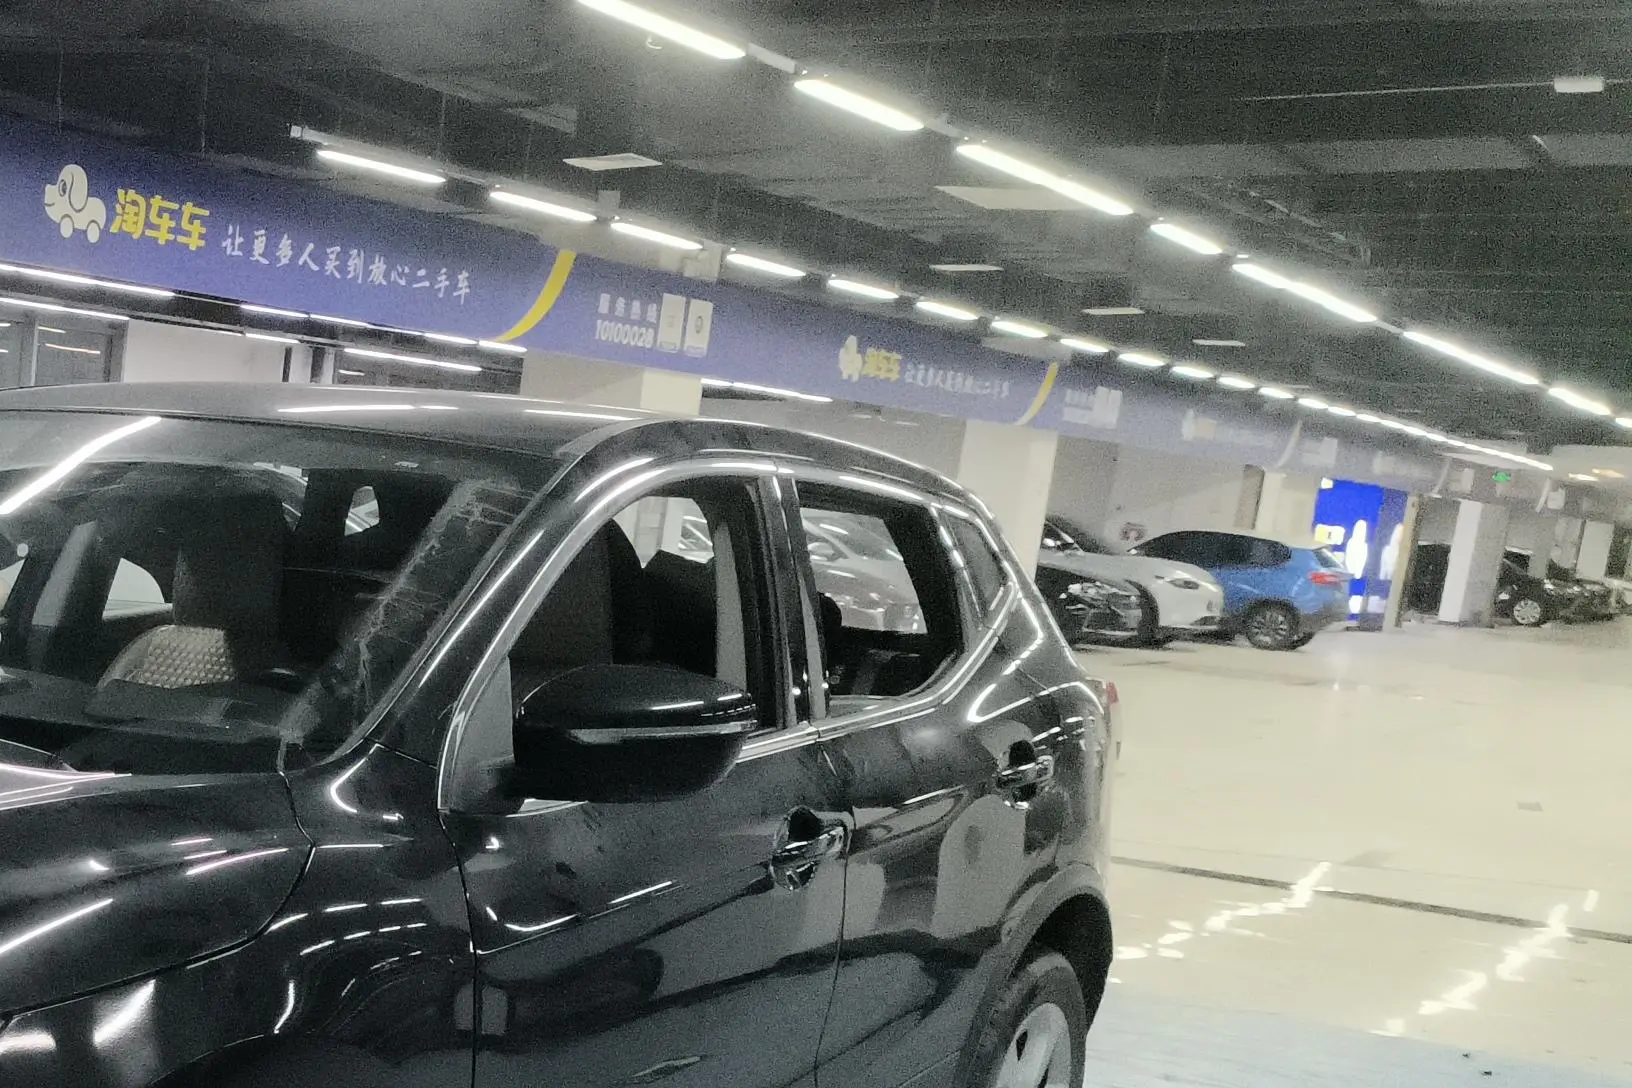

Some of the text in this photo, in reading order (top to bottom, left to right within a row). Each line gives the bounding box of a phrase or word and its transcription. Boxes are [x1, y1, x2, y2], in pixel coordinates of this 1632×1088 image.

[109, 187, 211, 251] 淘车车
[221, 223, 471, 305] 让更多人买到放心二手车
